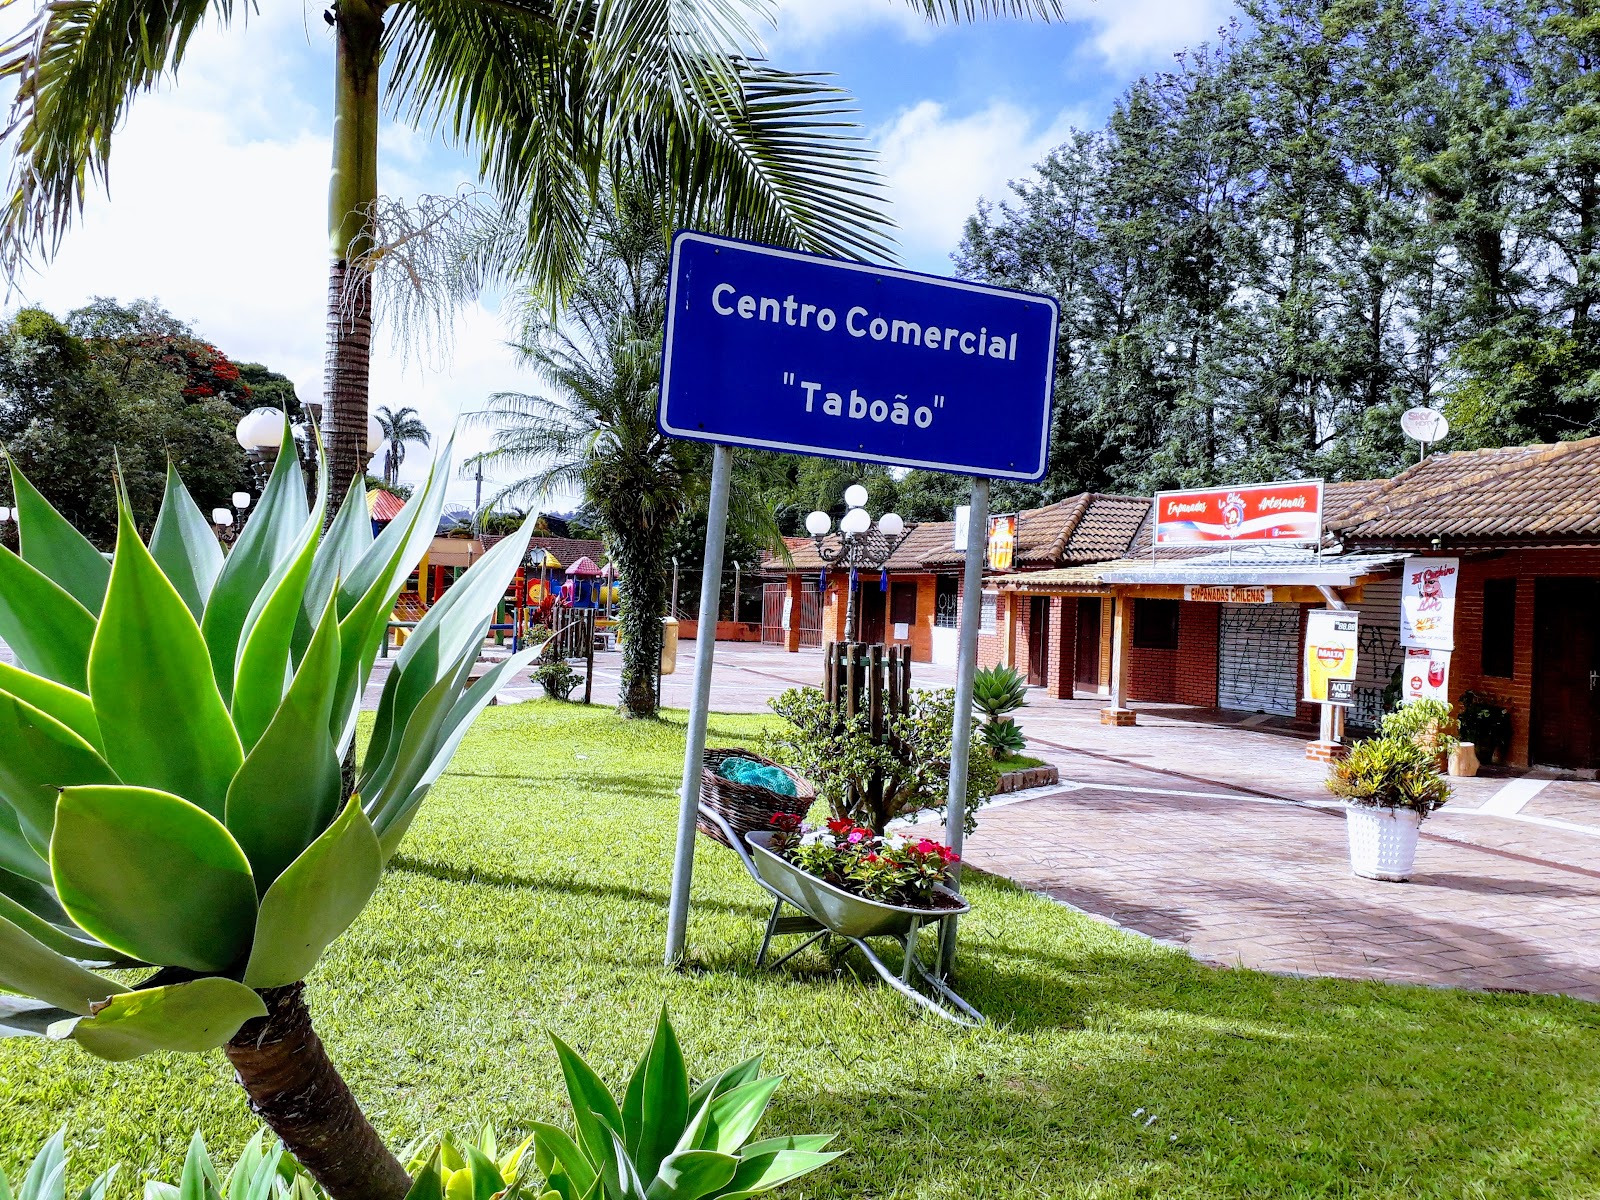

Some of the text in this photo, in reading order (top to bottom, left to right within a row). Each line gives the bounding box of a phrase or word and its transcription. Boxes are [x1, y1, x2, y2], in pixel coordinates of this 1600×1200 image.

[711, 282, 1018, 361] Centro Comercial
[782, 371, 946, 430] "Taboão"
[1167, 495, 1307, 516] Empanadas Artesanais
[1190, 587, 1265, 603] EMPANADAS CHILENAS
[1318, 649, 1344, 658] MALTA
[1331, 683, 1352, 692] AQUI
